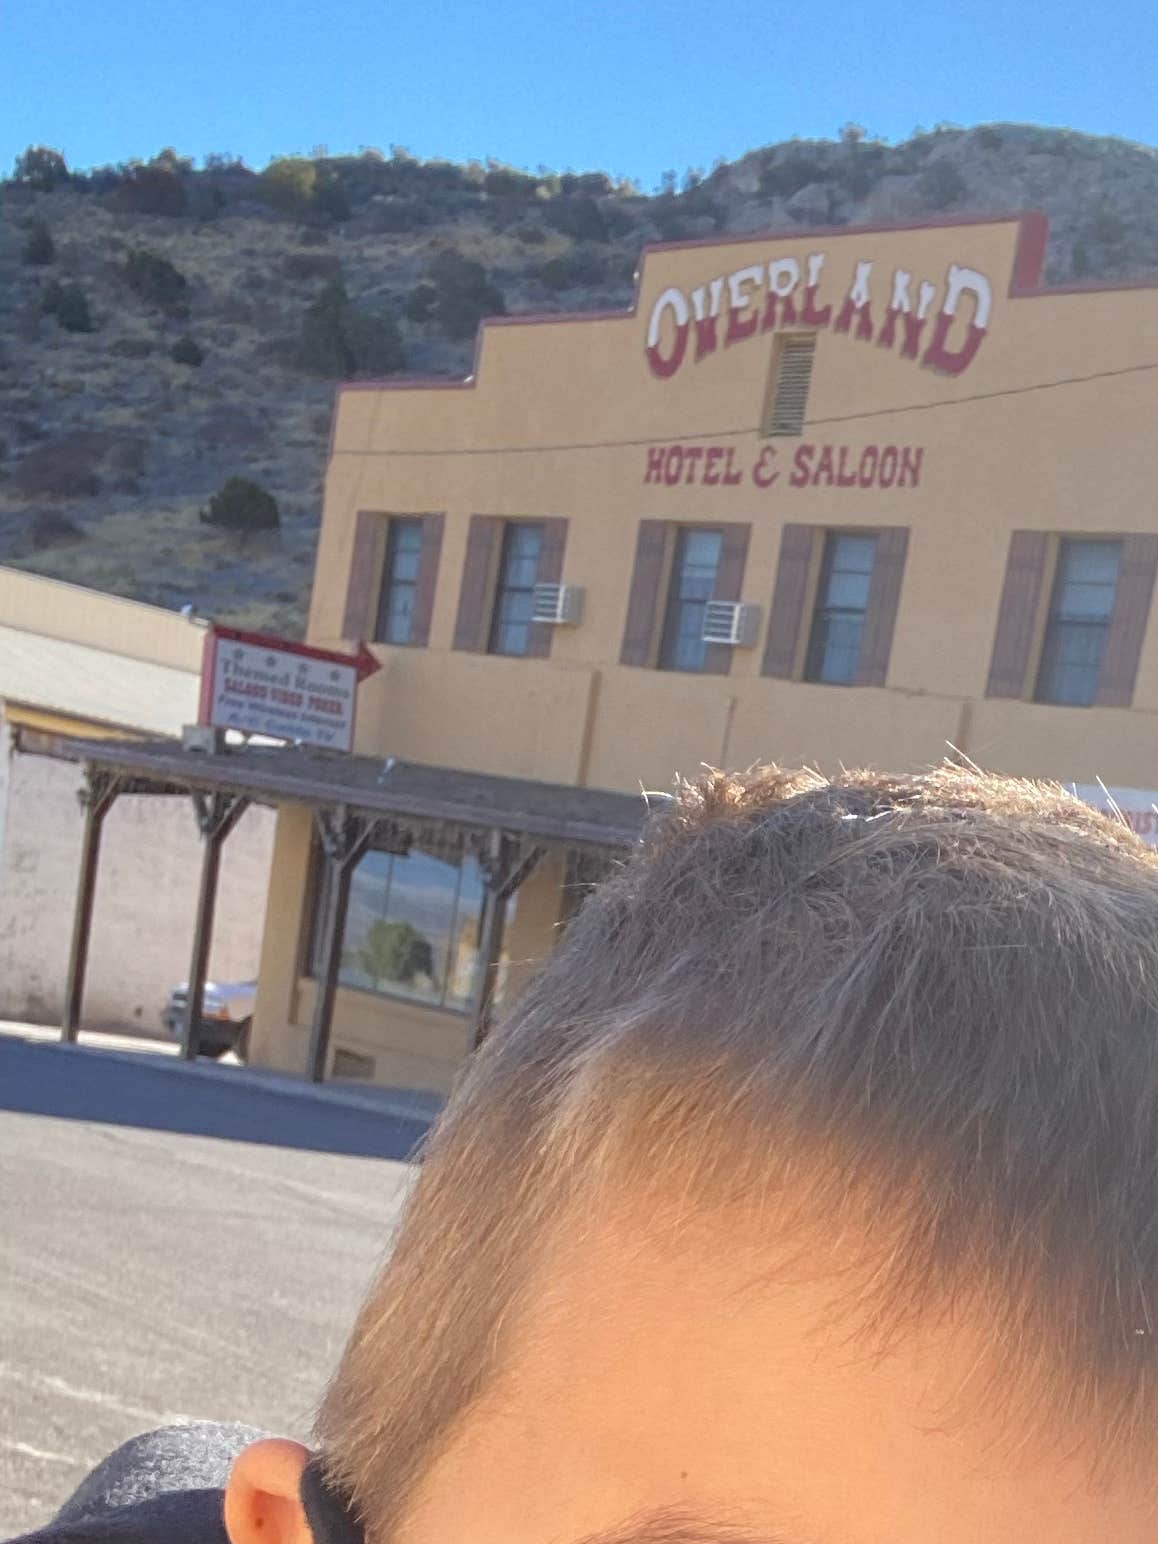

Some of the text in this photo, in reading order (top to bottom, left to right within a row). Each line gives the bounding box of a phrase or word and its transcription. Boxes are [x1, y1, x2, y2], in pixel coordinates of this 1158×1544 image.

[646, 253, 992, 379] OVERLAND
[643, 444, 925, 489] HOTEL & SALOON
